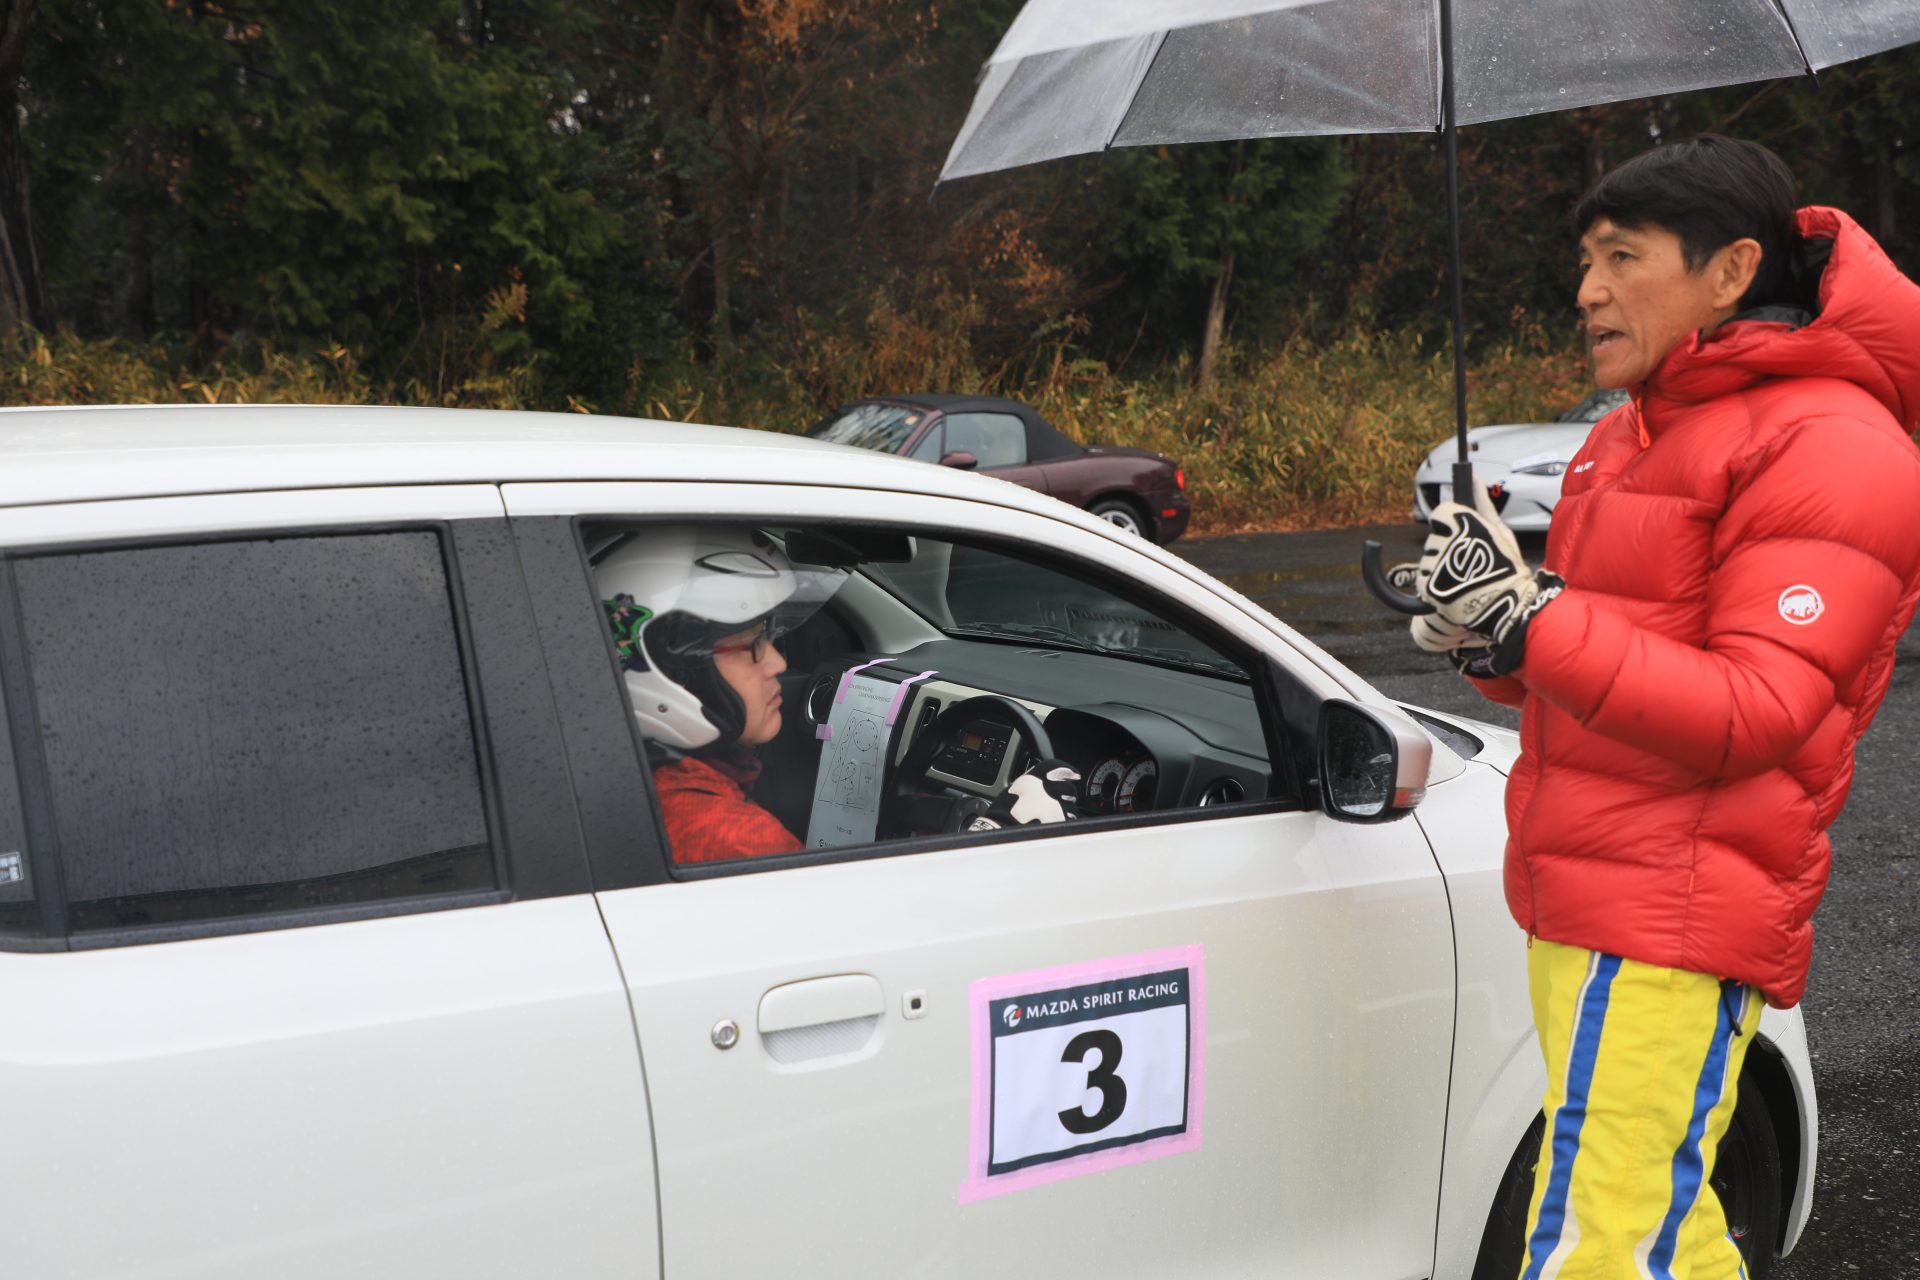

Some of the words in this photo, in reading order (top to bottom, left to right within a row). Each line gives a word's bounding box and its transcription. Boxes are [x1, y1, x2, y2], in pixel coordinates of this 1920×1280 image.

[1026, 999, 1078, 1019] MAZDA
[1083, 991, 1124, 1009] SPIRIT
[1128, 982, 1179, 1001] RACING
[1058, 1029, 1127, 1134] 3
